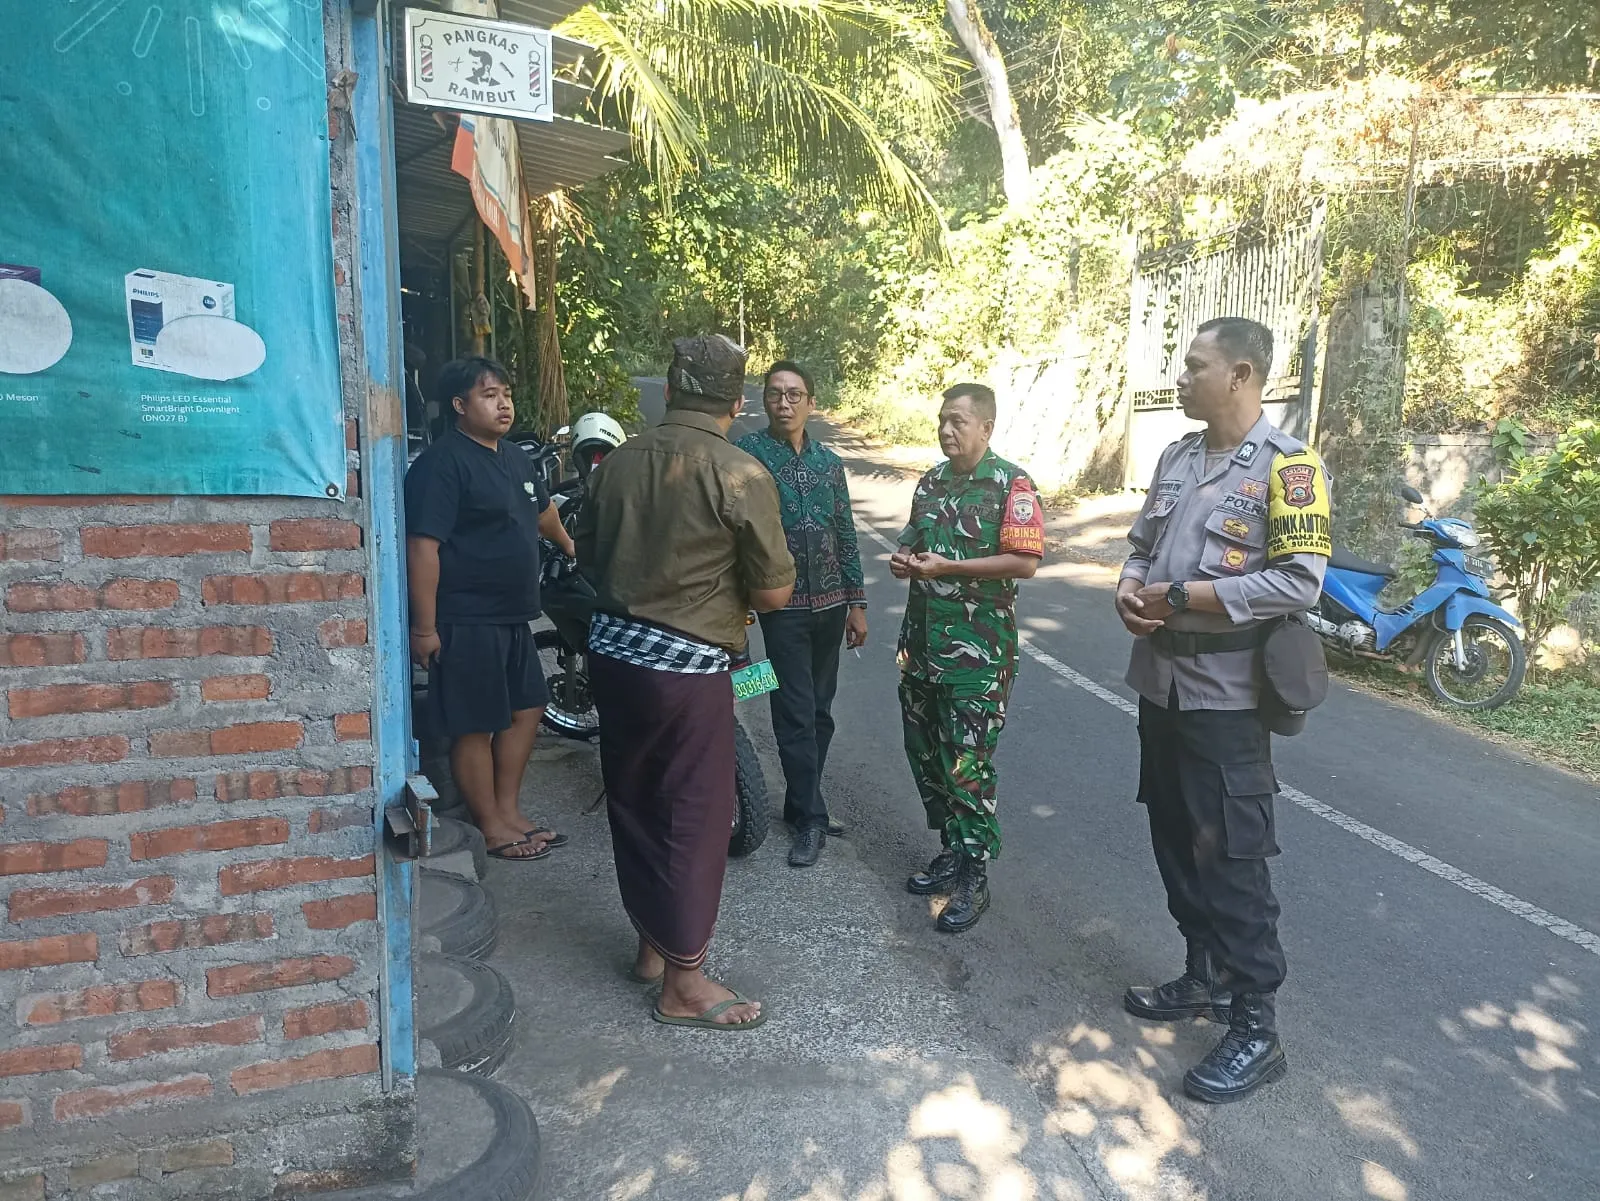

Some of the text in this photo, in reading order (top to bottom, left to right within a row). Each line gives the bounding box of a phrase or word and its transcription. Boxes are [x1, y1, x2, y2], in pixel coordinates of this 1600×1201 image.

[443, 29, 519, 55] PANGKAS
[448, 82, 516, 103] RAMBUT
[141, 394, 171, 404] Philips
[192, 395, 232, 404] Essential
[141, 404, 240, 415] SmartBright Downlight
[1224, 496, 1267, 515] POLRI
[1287, 534, 1314, 542] PANJI
